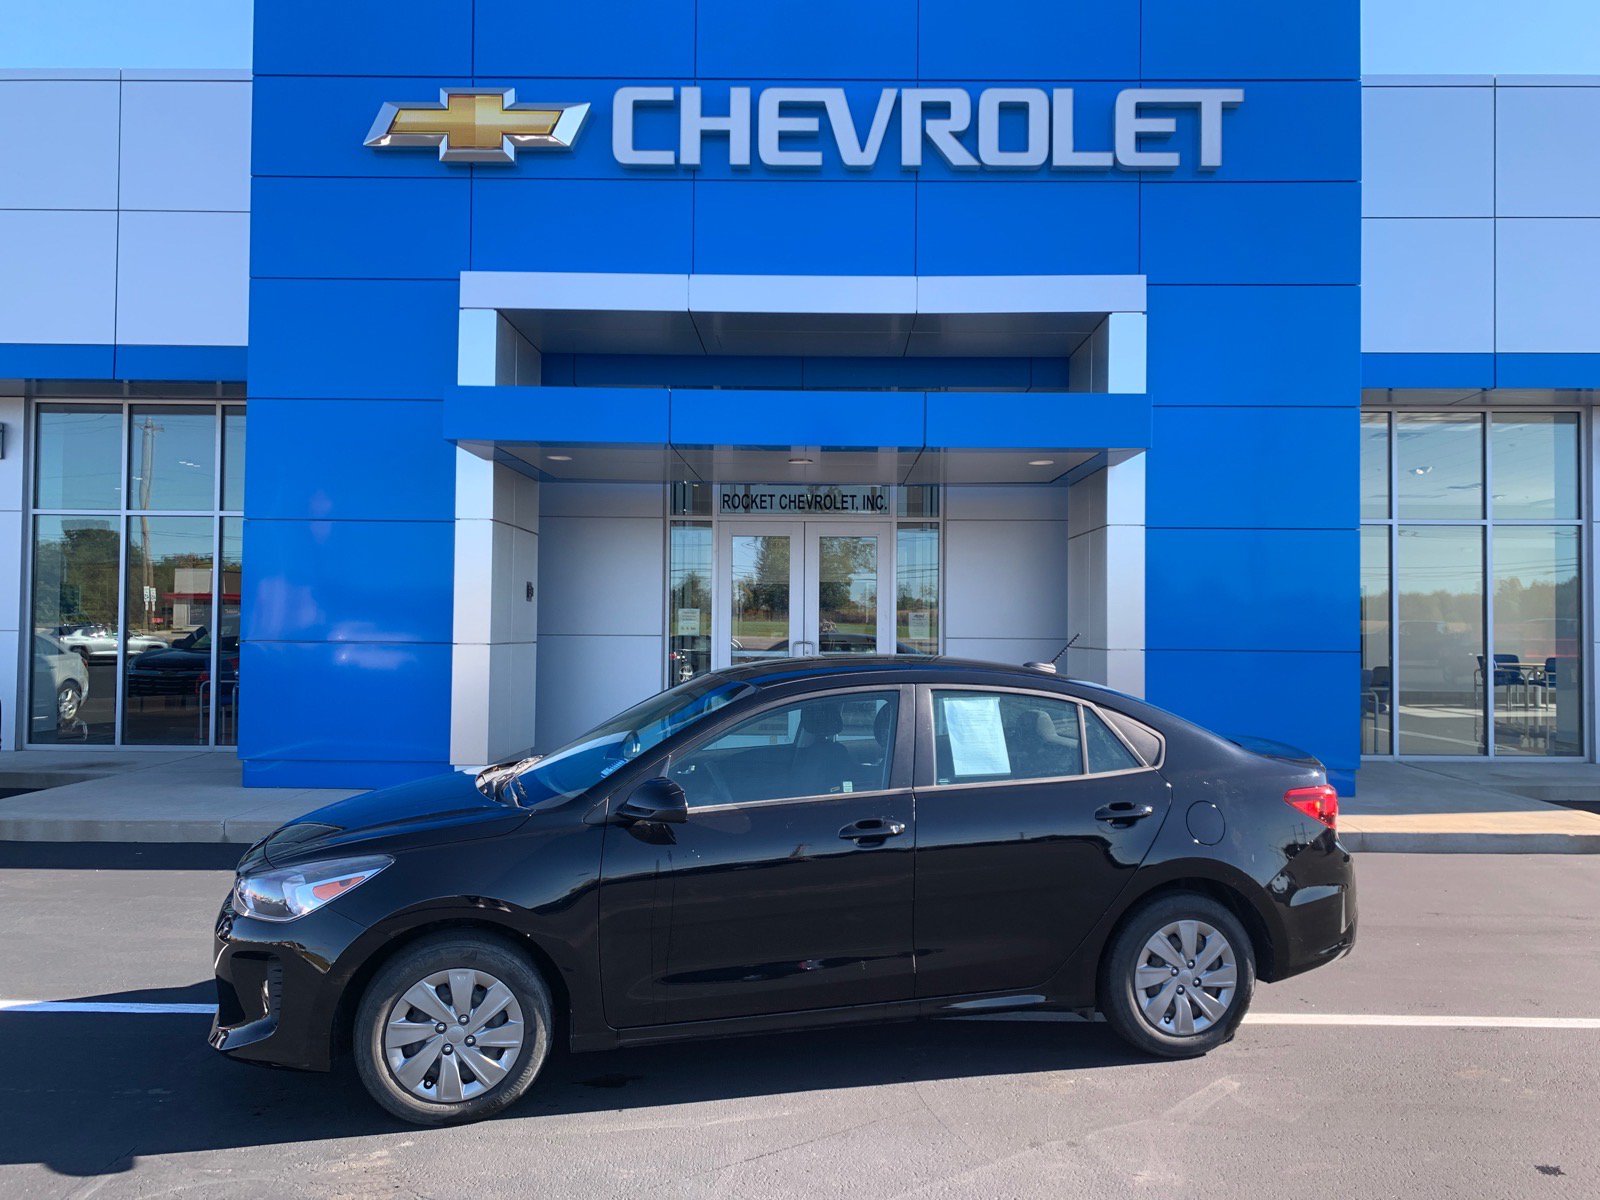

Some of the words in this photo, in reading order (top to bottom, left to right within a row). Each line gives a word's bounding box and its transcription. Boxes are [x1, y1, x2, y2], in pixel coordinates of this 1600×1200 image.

[612, 86, 1244, 168] CHEVROLET
[722, 493, 776, 510] ROCKET
[779, 493, 858, 512] CHEVROLET,
[862, 494, 887, 510] INC.
